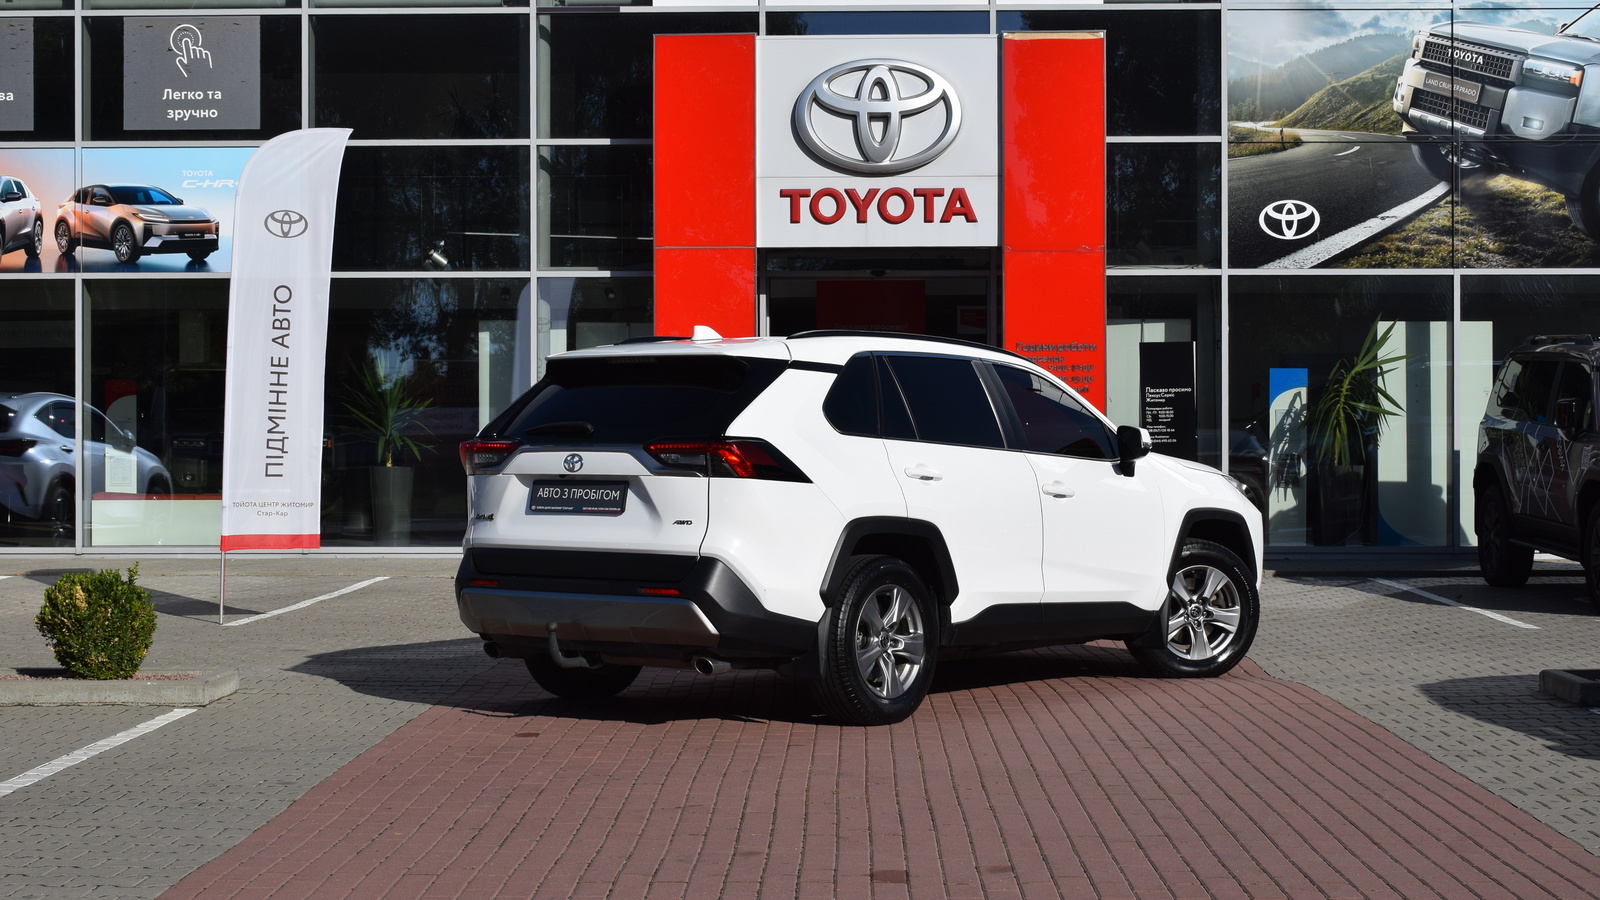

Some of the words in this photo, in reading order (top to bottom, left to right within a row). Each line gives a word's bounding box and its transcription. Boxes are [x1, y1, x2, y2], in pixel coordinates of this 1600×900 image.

[1447, 48, 1483, 64] TOYOTA
[163, 88, 203, 101] Легко
[207, 90, 222, 101] та
[1425, 78, 1438, 86] LAND
[1460, 86, 1477, 96] PRADO
[167, 107, 218, 121] зручно
[780, 187, 978, 224] TOYOTA
[272, 284, 293, 349] АВТО
[1016, 342, 1055, 352] Години
[1057, 342, 1097, 353] роботи
[265, 356, 290, 478] ПІДМІННЕ
[537, 487, 561, 498] АВТО
[570, 489, 620, 501] ПРОБІГОМ
